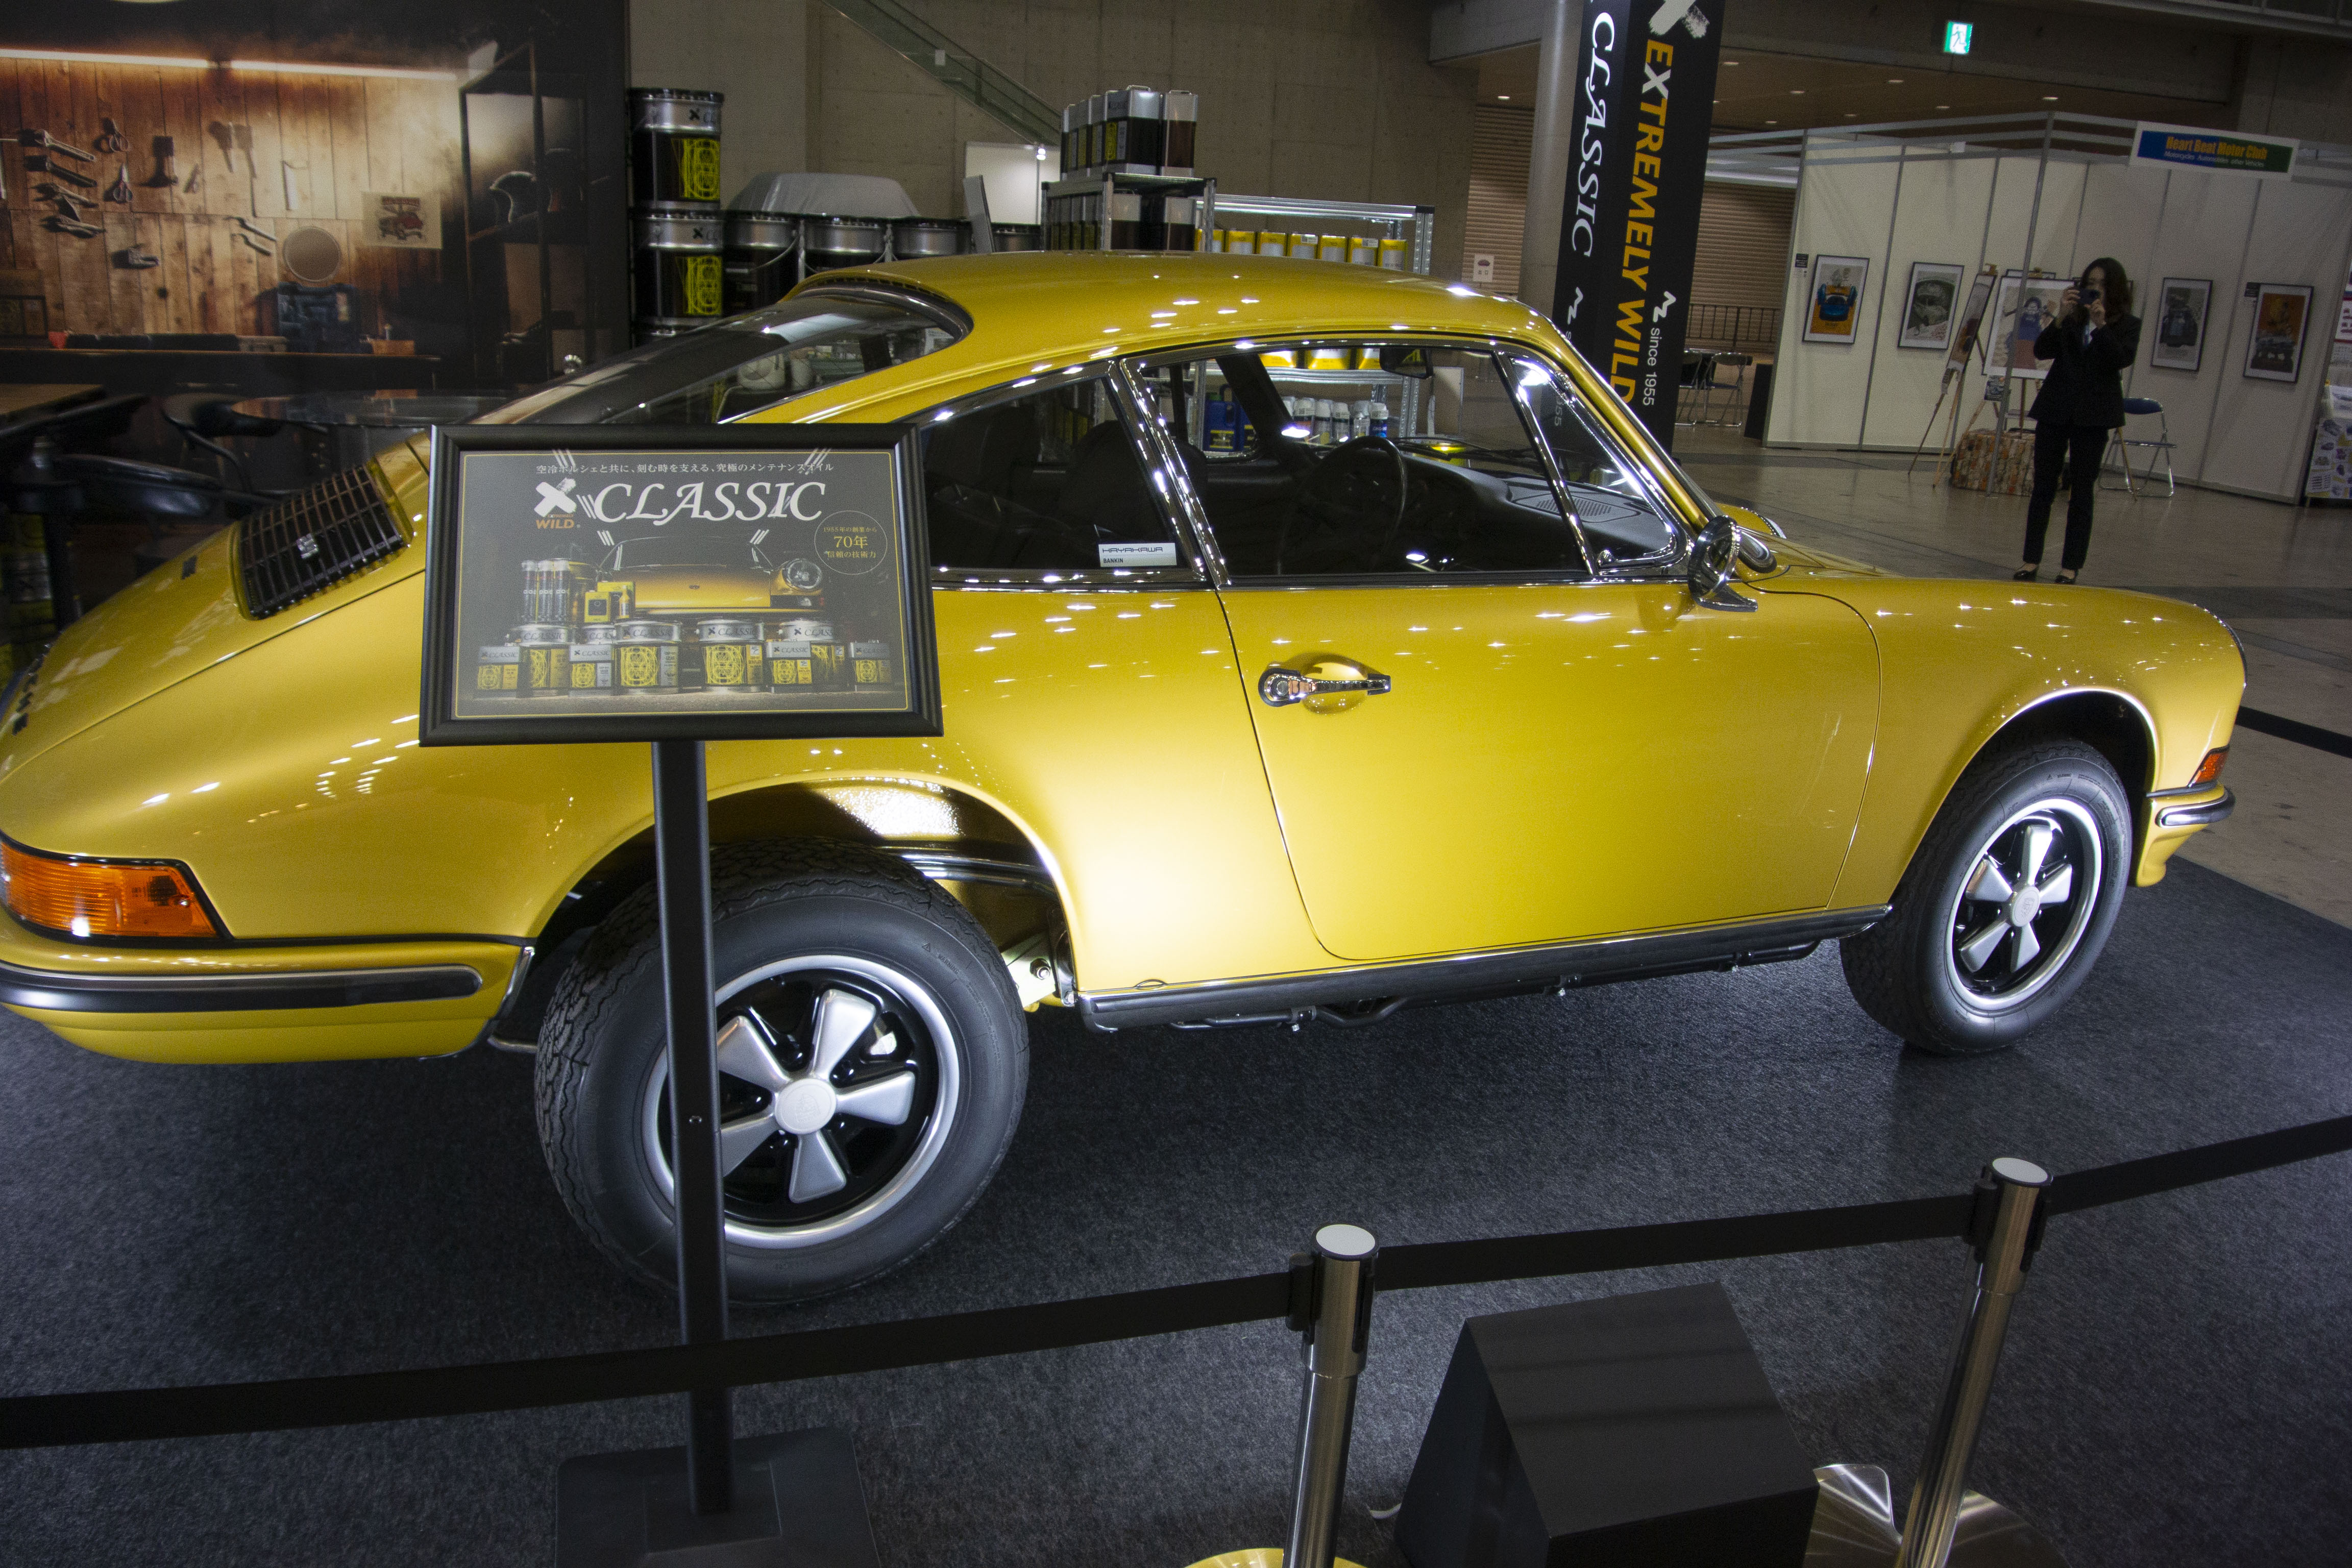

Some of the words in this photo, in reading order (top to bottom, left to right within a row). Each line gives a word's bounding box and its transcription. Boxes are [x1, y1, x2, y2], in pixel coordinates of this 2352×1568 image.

[1571, 12, 1615, 258] CLASSIC
[2166, 136, 2193, 151] Heart
[2194, 139, 2217, 154] Beat
[2217, 142, 2245, 157] Motor
[2245, 145, 2268, 160] Club
[1622, 39, 1674, 292] EXTREMELY
[1610, 299, 1646, 403] WILD
[1647, 328, 1662, 366] since
[1643, 372, 1658, 406] 1955
[594, 481, 826, 526] CLASSIC
[536, 519, 575, 529] WILD
[834, 535, 868, 549] 70年
[938, 954, 960, 974] WARNING
